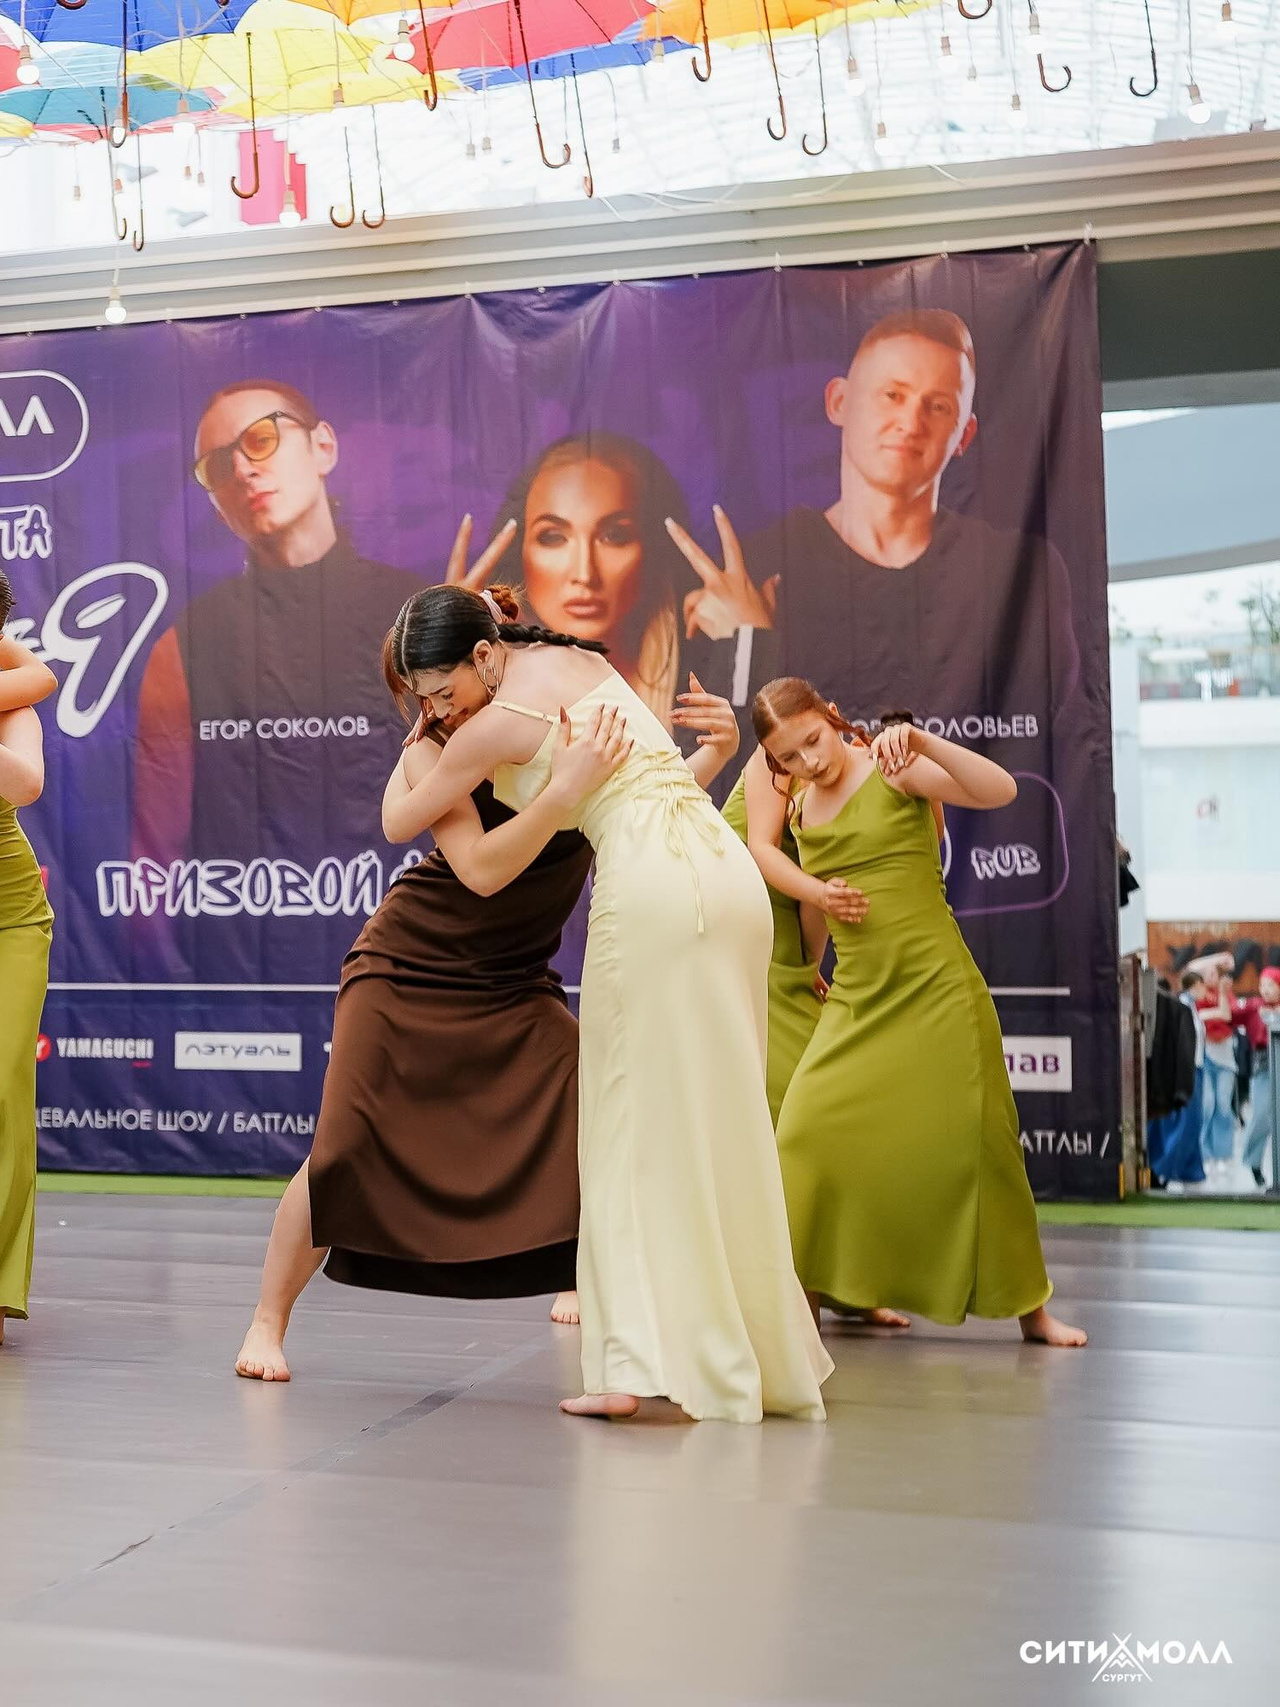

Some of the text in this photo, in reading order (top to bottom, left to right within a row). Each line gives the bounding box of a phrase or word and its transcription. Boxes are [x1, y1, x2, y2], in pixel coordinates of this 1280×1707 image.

[199, 715, 370, 741] ЕГОР СОКОЛОВ
[914, 714, 1039, 739] ОЛОВЬЕВ
[970, 843, 1041, 880] RUB
[95, 849, 384, 918] ПРИЗОВОЙ
[56, 1037, 154, 1059] YAMAGUCHI
[156, 1108, 214, 1133] ШОУ
[233, 1111, 316, 1135] БАТТЛЫ
[1019, 1130, 1093, 1156] АТТЛЫ
